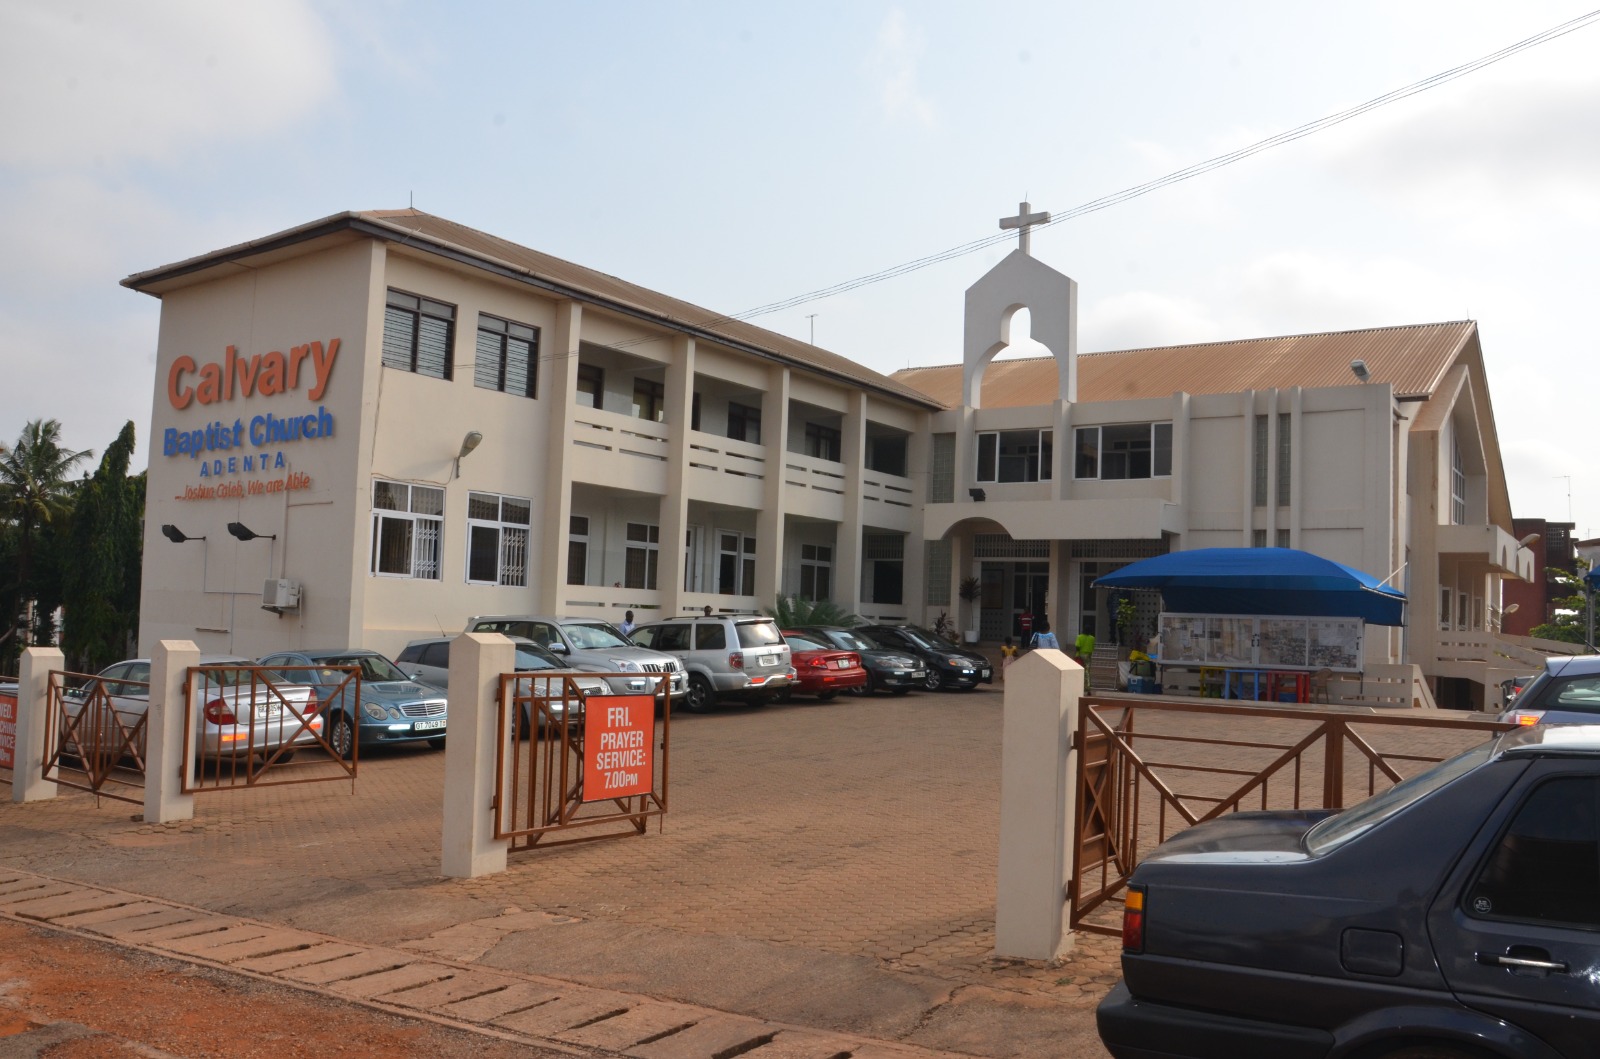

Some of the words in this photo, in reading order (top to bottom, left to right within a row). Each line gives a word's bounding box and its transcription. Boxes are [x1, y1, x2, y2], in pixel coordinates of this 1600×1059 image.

[168, 338, 341, 410] Calvary
[164, 418, 242, 458] Baptist
[250, 406, 333, 447] Church
[200, 452, 285, 477] ADENTA
[247, 480, 264, 495] We
[266, 479, 283, 493] are
[285, 471, 310, 491] Able
[607, 707, 632, 728] FRI.
[601, 731, 643, 750] PRAYER
[596, 750, 645, 770] SERVICE:
